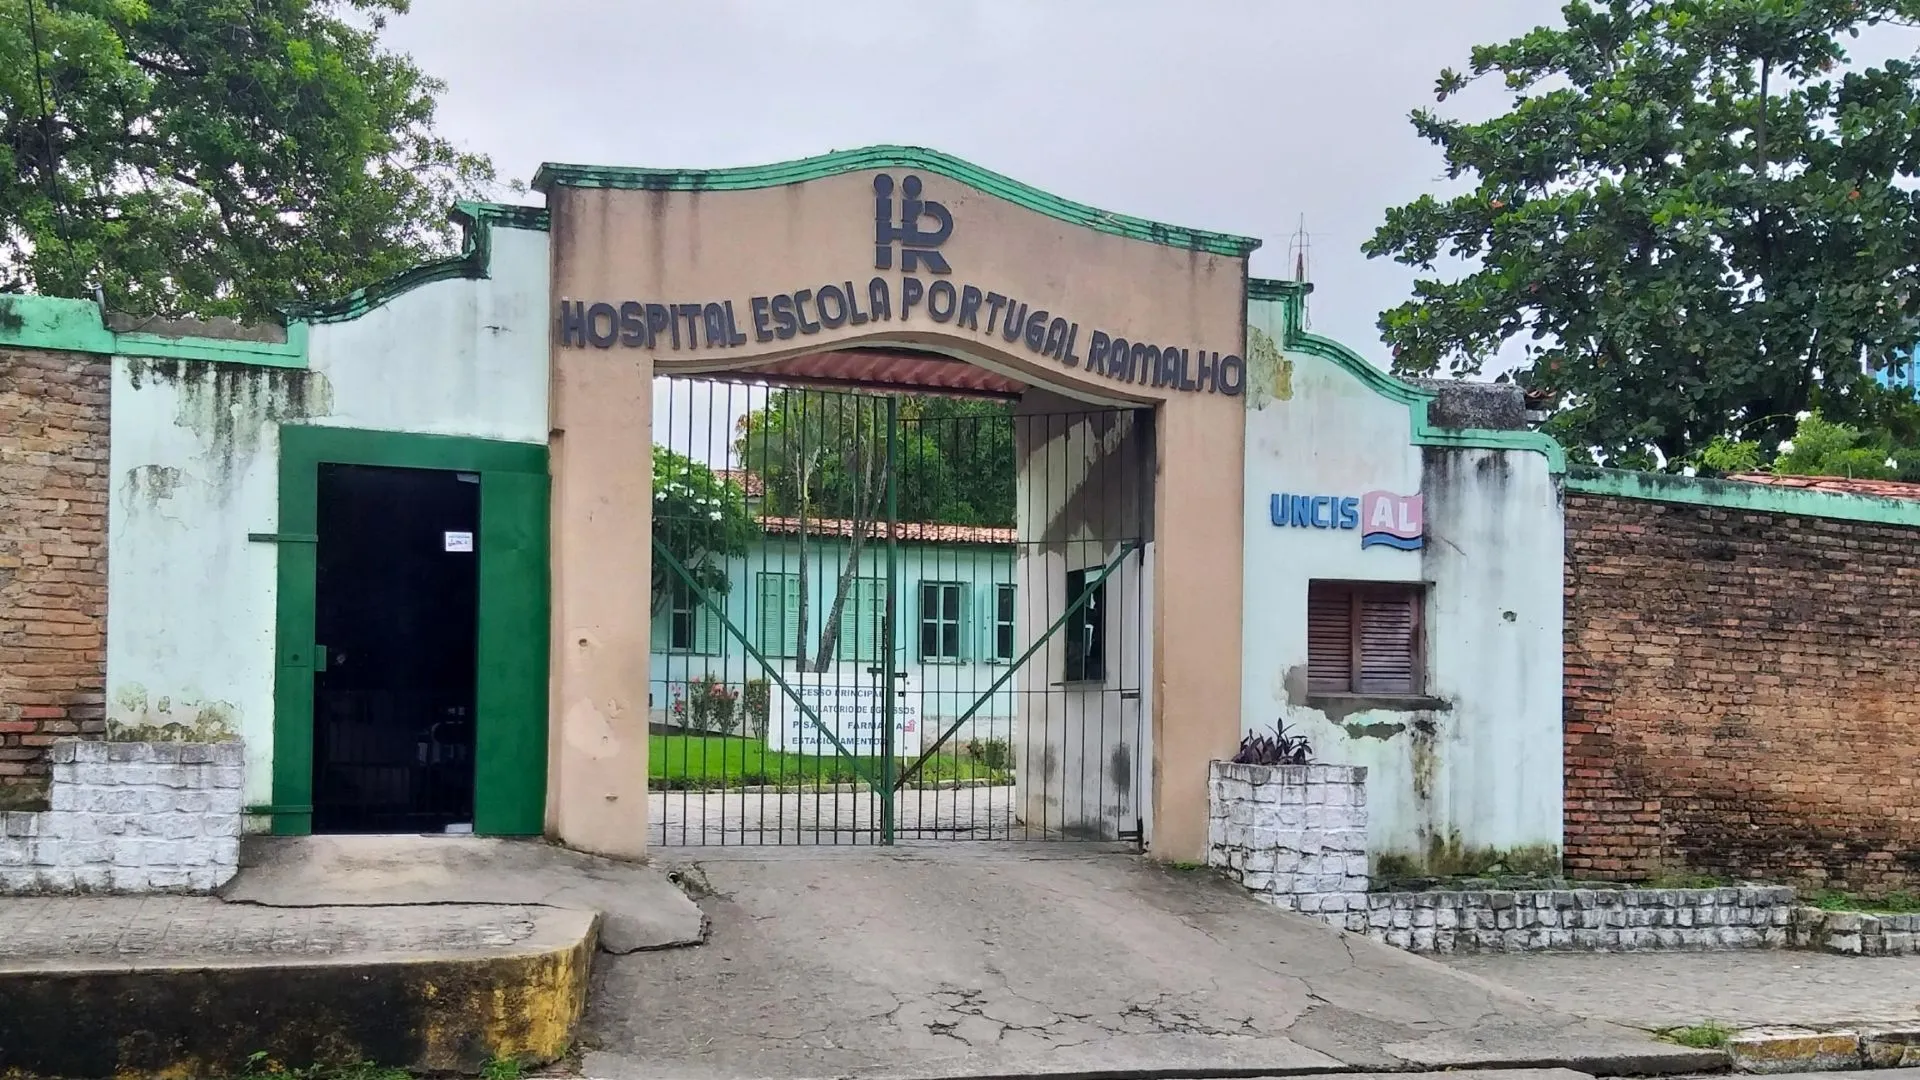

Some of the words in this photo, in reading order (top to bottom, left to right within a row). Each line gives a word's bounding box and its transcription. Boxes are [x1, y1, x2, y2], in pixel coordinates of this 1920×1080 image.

[561, 300, 747, 350] HOSPITAL
[751, 277, 892, 343] ESCOLA
[901, 277, 1080, 368] PORTUGAL
[1084, 329, 1245, 396] RAMALHO
[794, 688, 832, 697] ACESSO
[835, 689, 884, 698] PRINCIPAL
[856, 706, 868, 714] DE
[870, 706, 916, 715] EGSSOS
[792, 721, 827, 729] PSA
[847, 721, 903, 730] FARMAA
[792, 736, 881, 746] ESTACIOAMENTO
